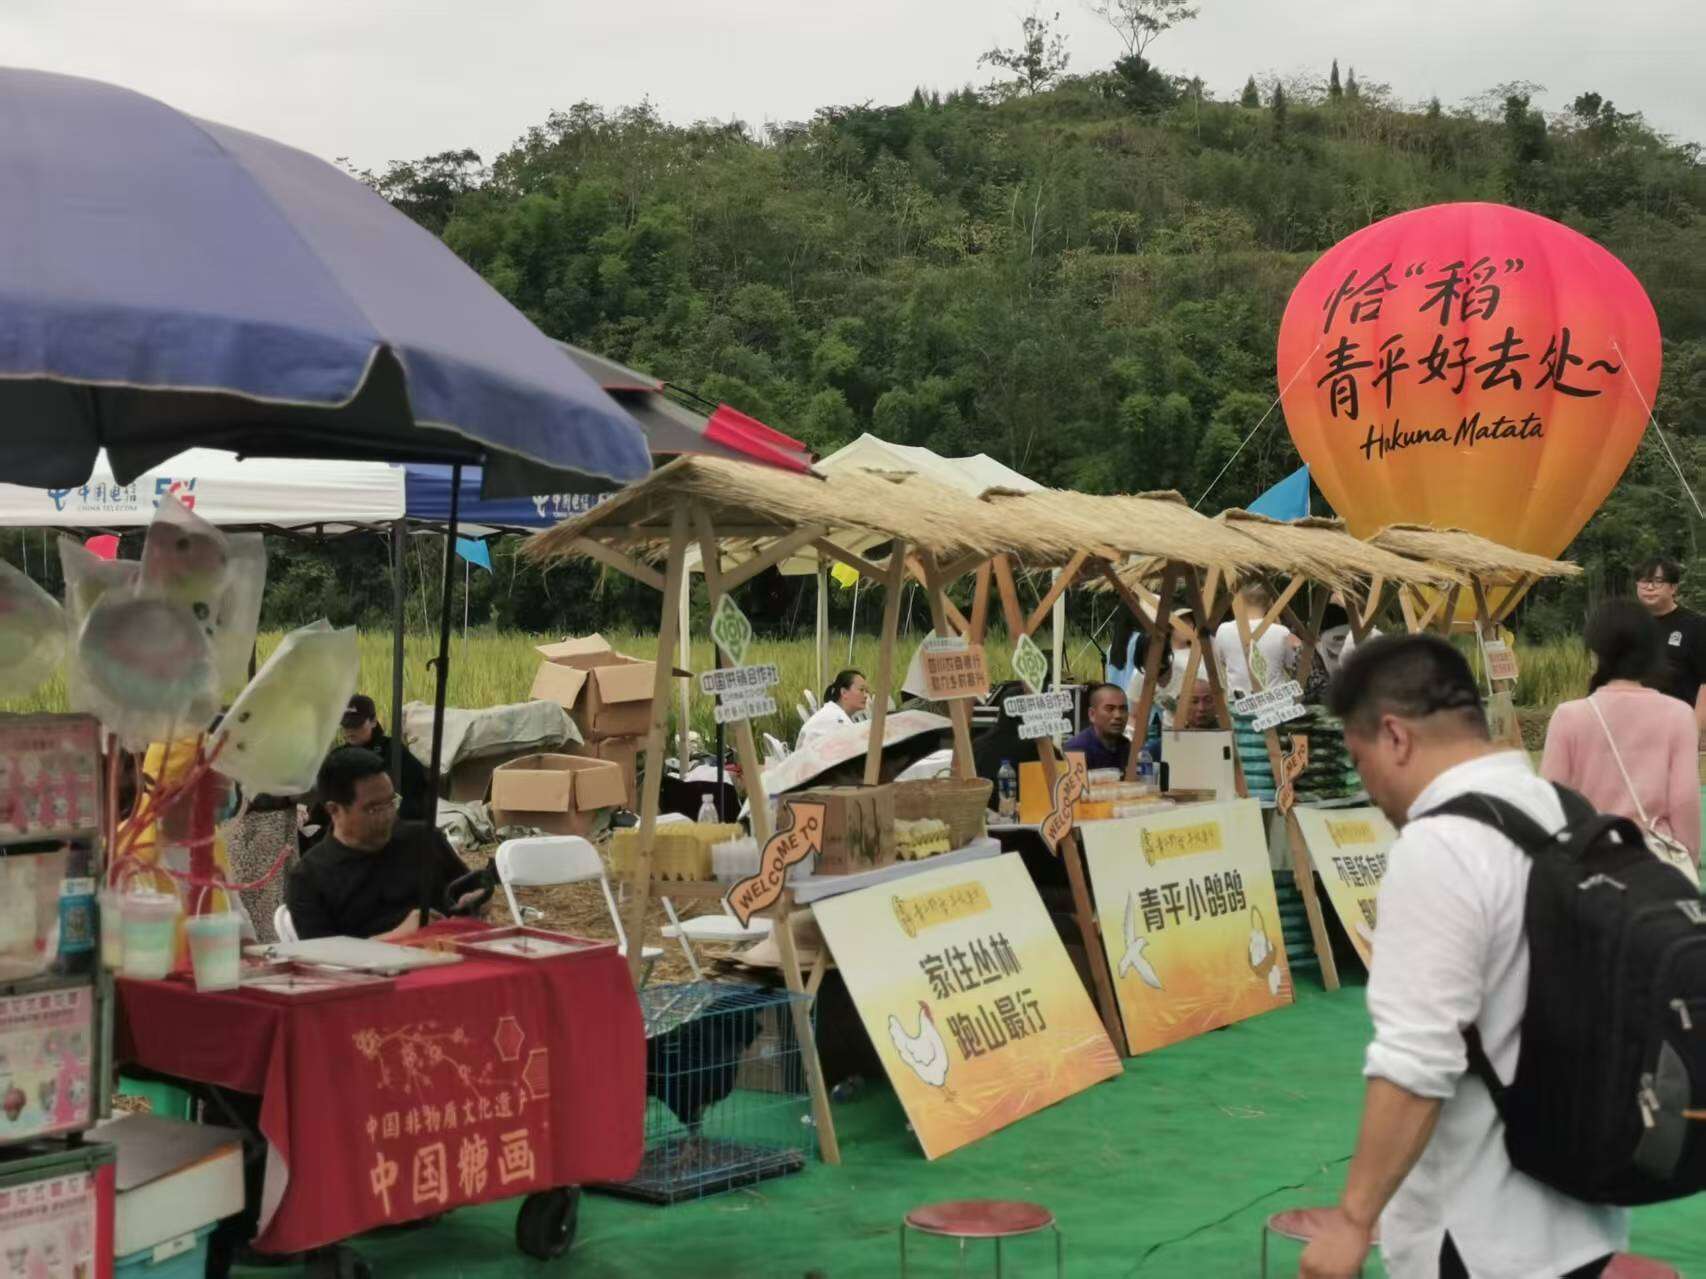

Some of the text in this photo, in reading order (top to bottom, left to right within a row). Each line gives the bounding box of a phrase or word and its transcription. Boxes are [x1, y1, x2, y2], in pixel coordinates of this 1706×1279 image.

[1453, 412, 1545, 447] Matata
[1048, 776, 1076, 839] WELCOME
[739, 815, 819, 910] WELCOME TO
[1138, 869, 1247, 933] 青平小鸽鸽
[919, 932, 1022, 1000] 家住丛林
[946, 988, 1047, 1061] 跑山最行
[370, 1128, 535, 1217] 中国糖画
